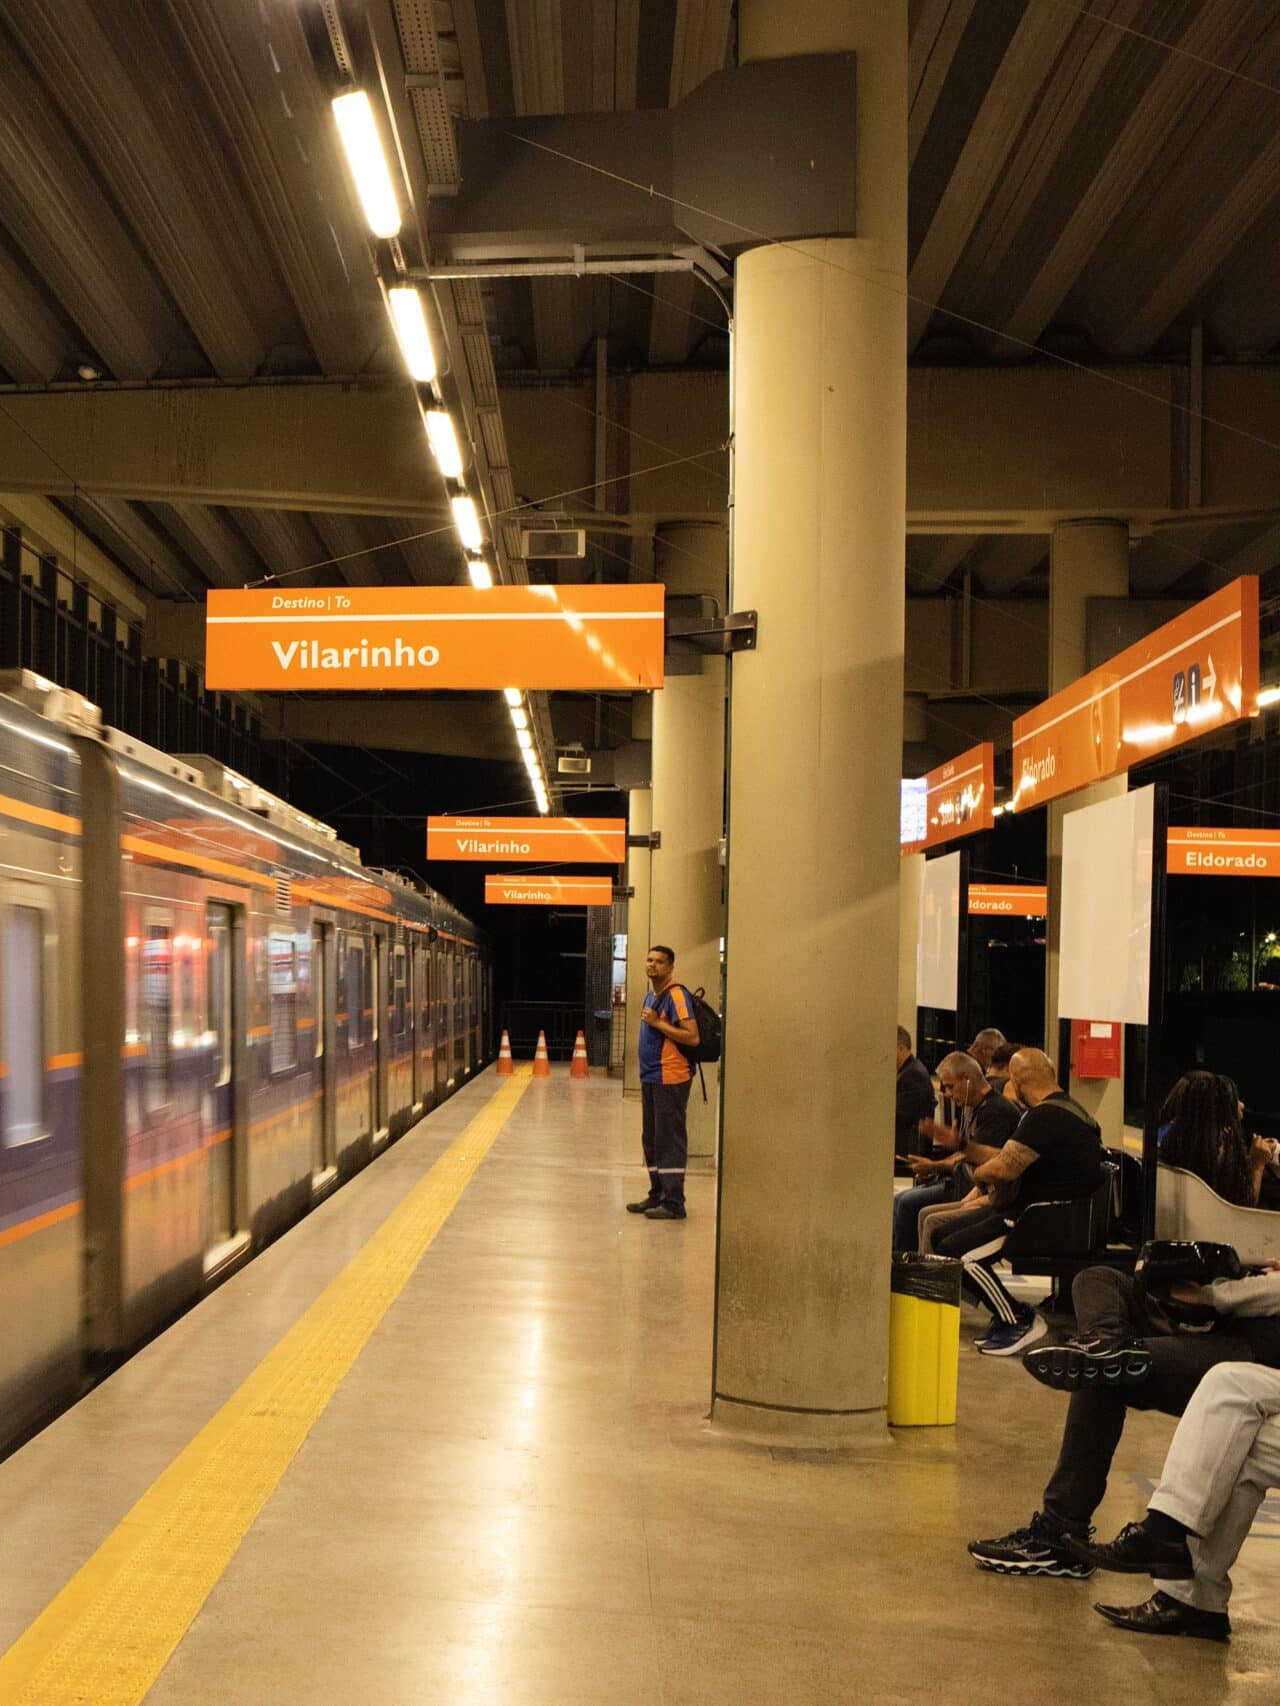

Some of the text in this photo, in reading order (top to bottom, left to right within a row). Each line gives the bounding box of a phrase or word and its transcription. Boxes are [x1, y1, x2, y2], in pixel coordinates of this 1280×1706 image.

[272, 596, 325, 609] Destino
[335, 595, 351, 609] To
[271, 637, 440, 670] Vilarinho
[456, 839, 530, 854] Vilarinho
[1186, 851, 1267, 868] Eldorado
[503, 889, 551, 900] Vilarinho
[969, 900, 1013, 911] ldorado
